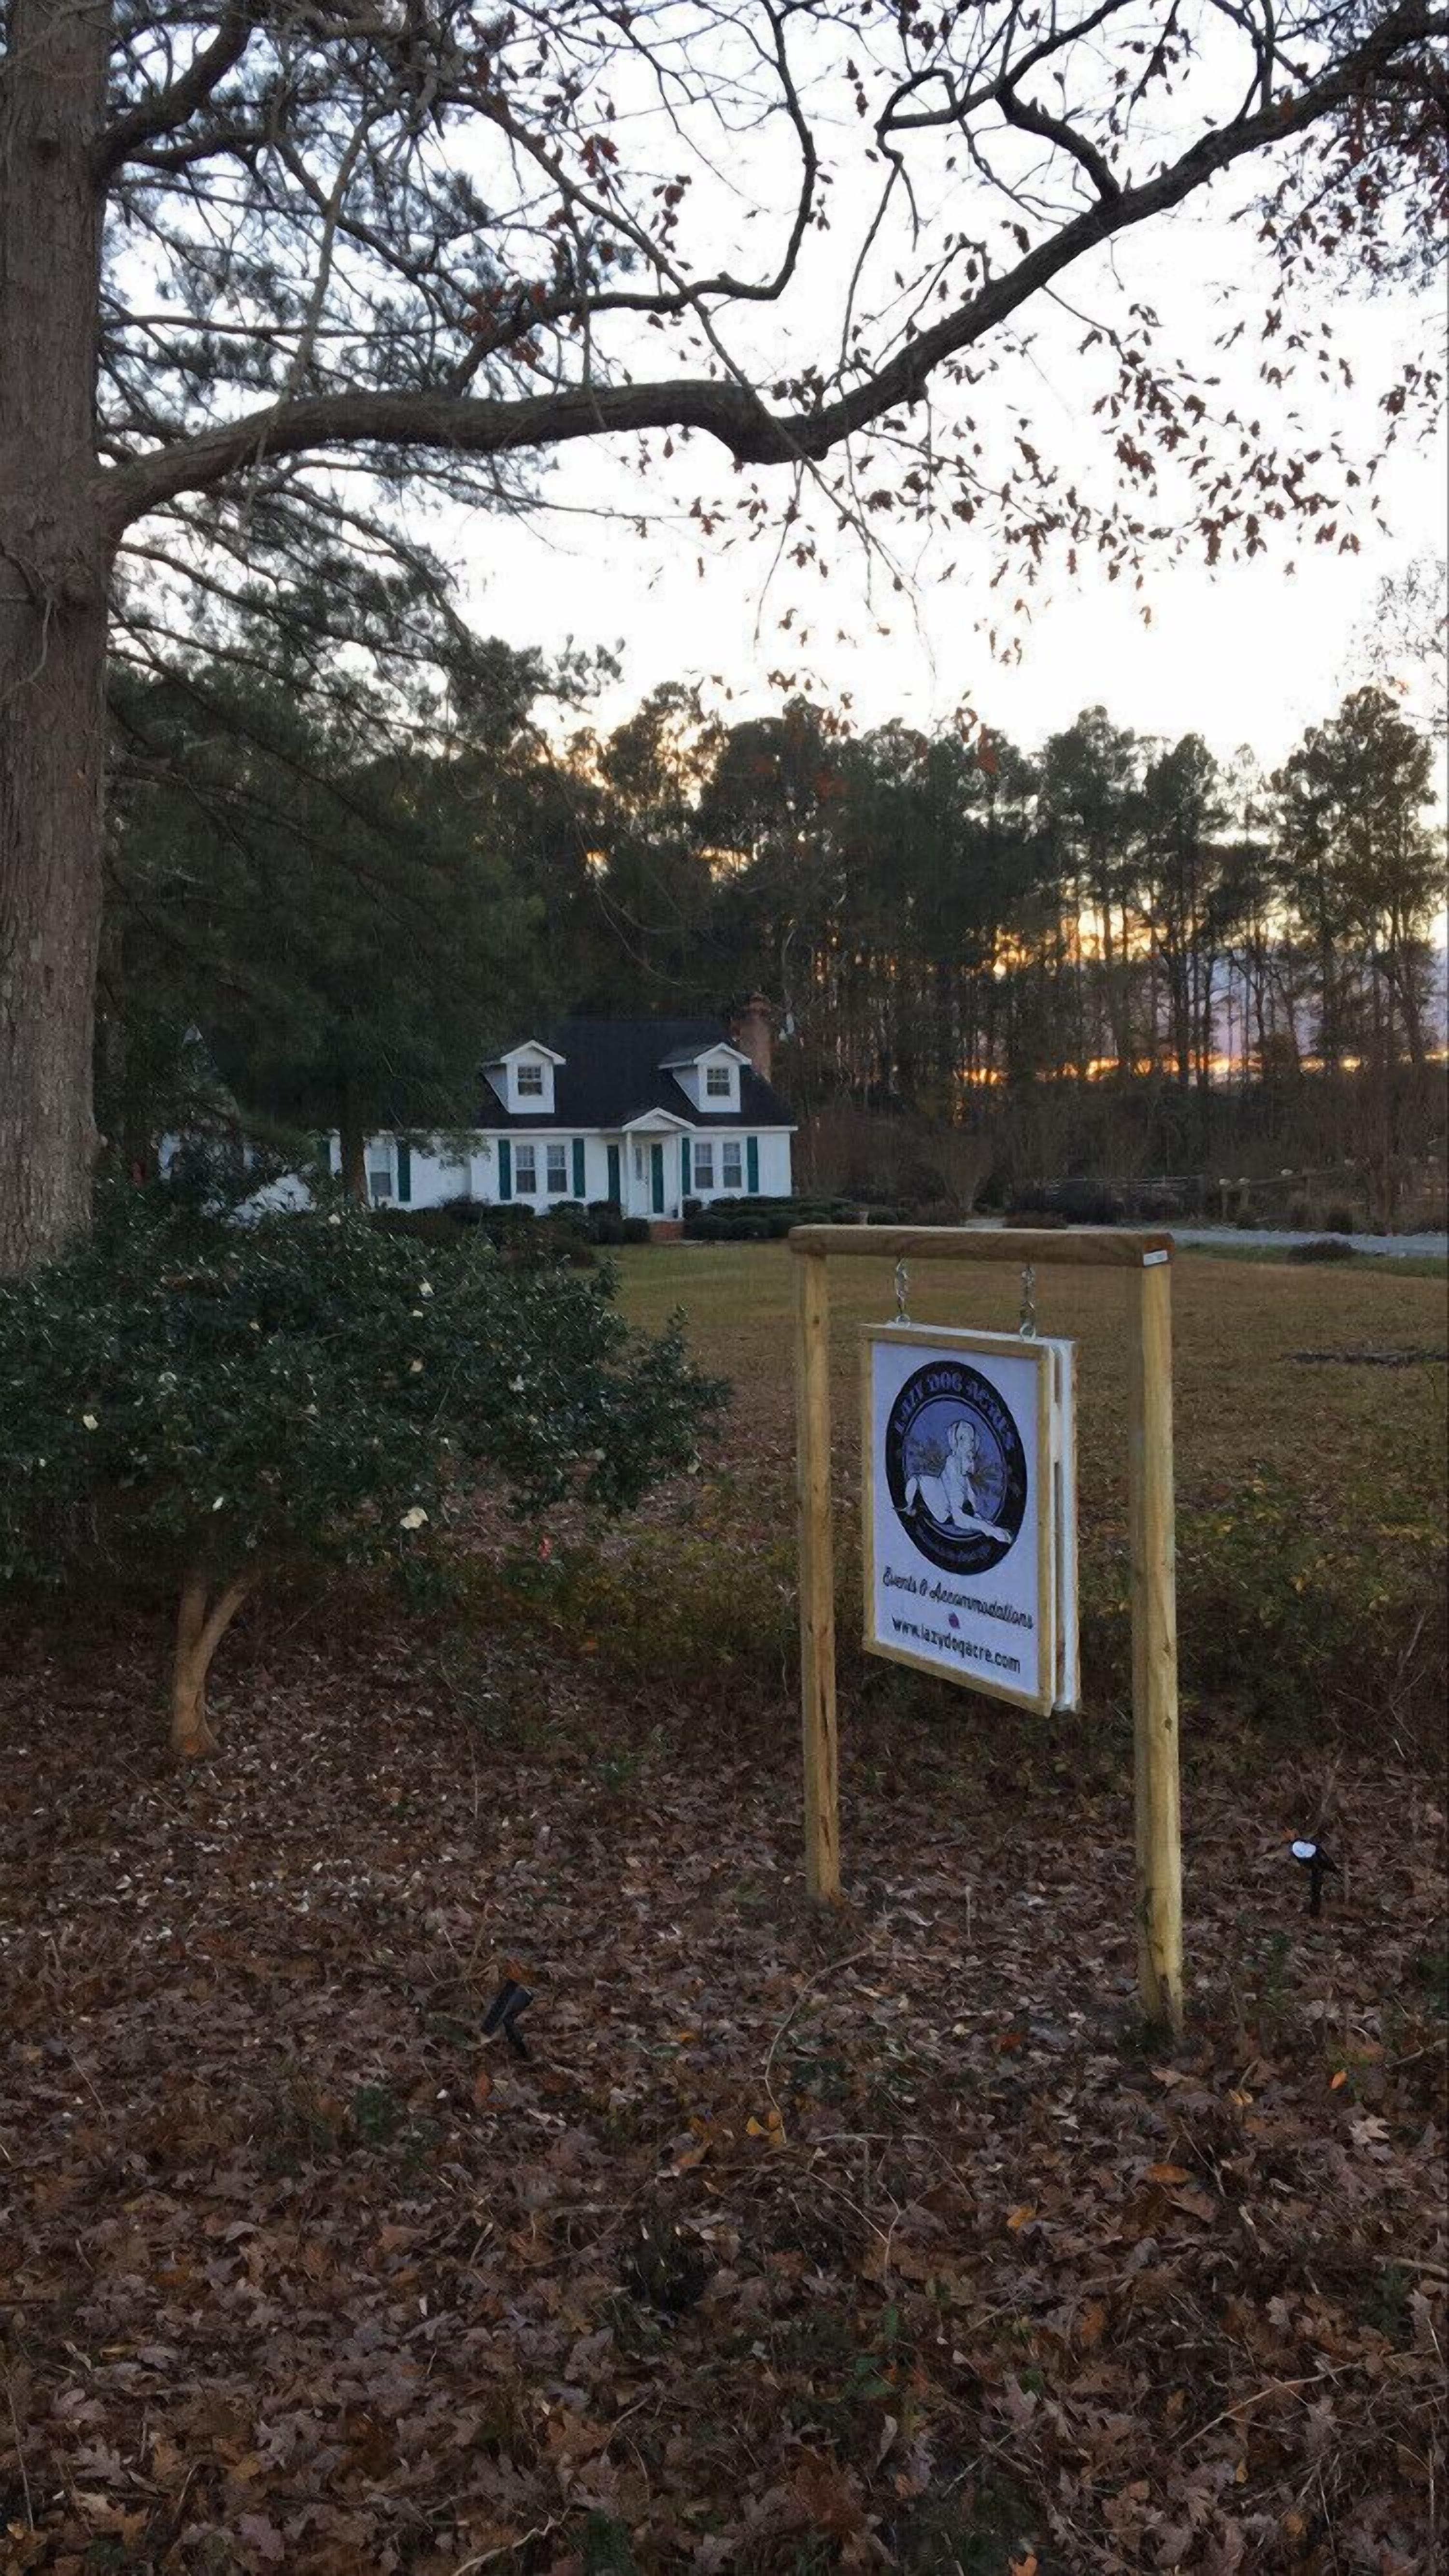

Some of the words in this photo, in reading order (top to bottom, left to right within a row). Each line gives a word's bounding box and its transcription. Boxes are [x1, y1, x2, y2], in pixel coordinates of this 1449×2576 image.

[927, 1371, 963, 1392] DOG
[882, 1565, 916, 1594] Events
[929, 1581, 1033, 1630] Accommodations
